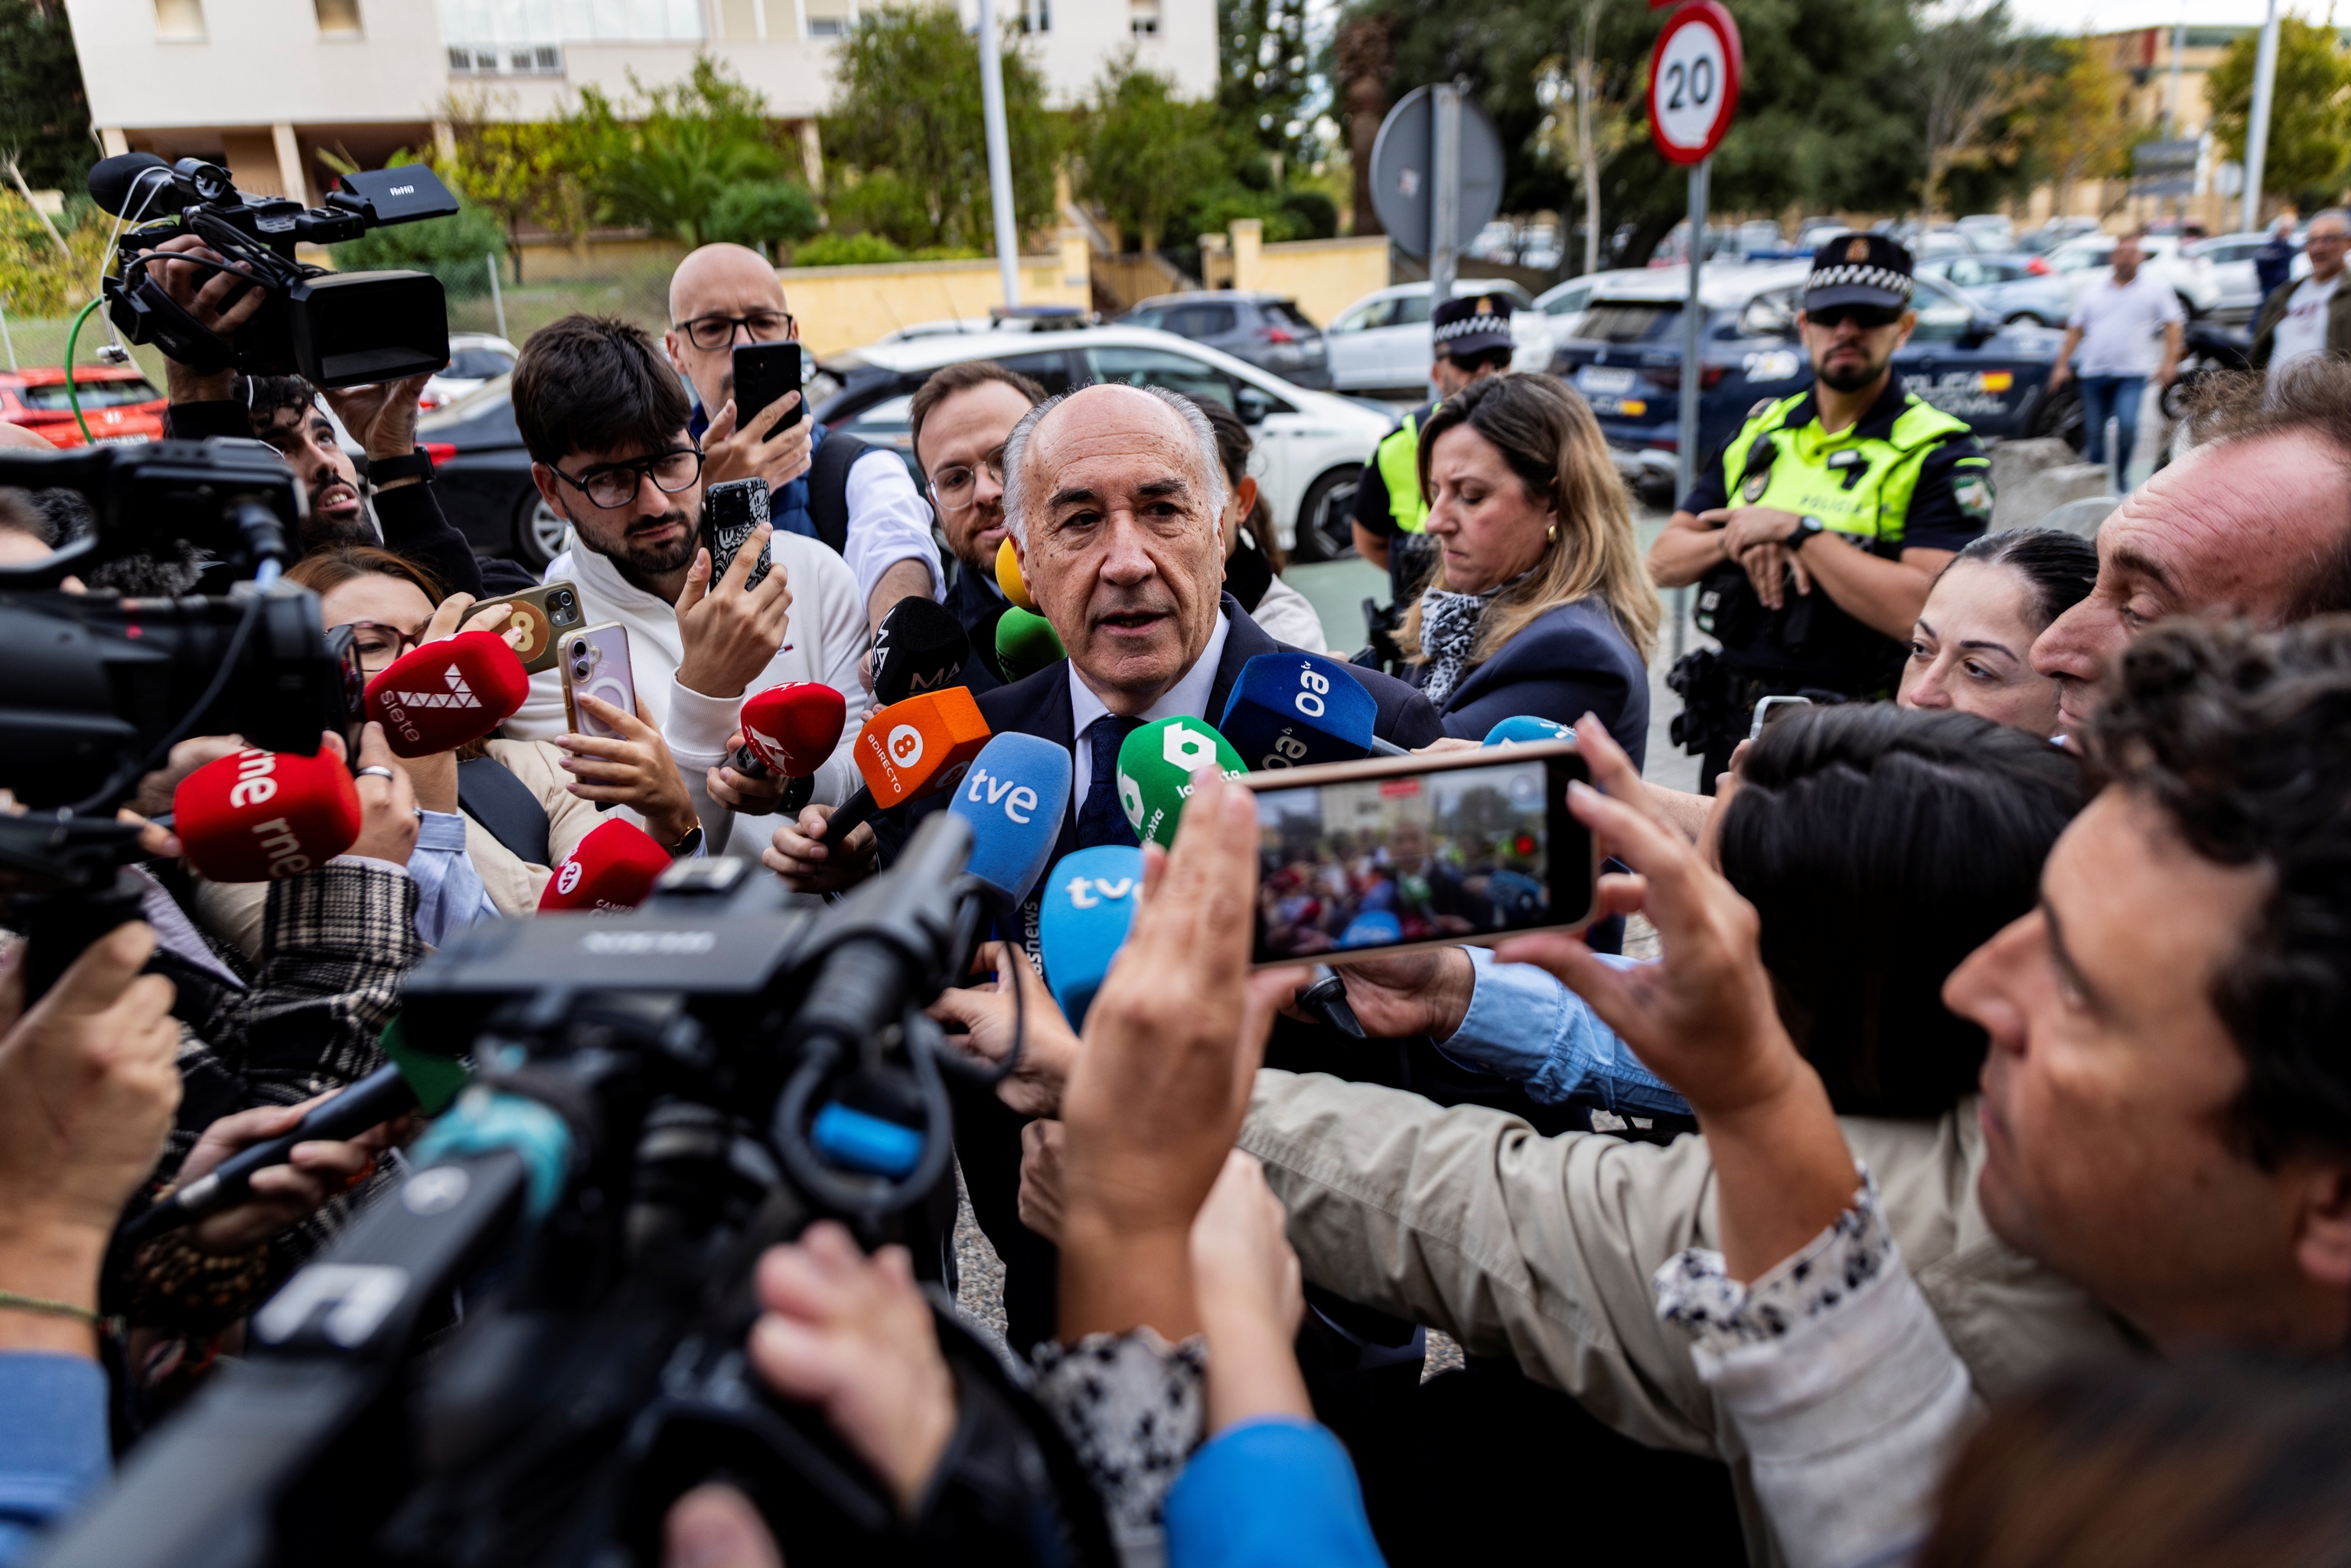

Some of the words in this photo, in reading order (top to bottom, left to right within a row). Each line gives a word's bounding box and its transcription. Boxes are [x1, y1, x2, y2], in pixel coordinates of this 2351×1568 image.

[1665, 54, 1714, 109] 20
[510, 611, 534, 652] 8
[867, 733, 902, 794] 8DIRECTO
[894, 734, 916, 758] 8
[968, 768, 1038, 824] tve
[251, 817, 311, 878] rne
[595, 898, 634, 914] CAMPO
